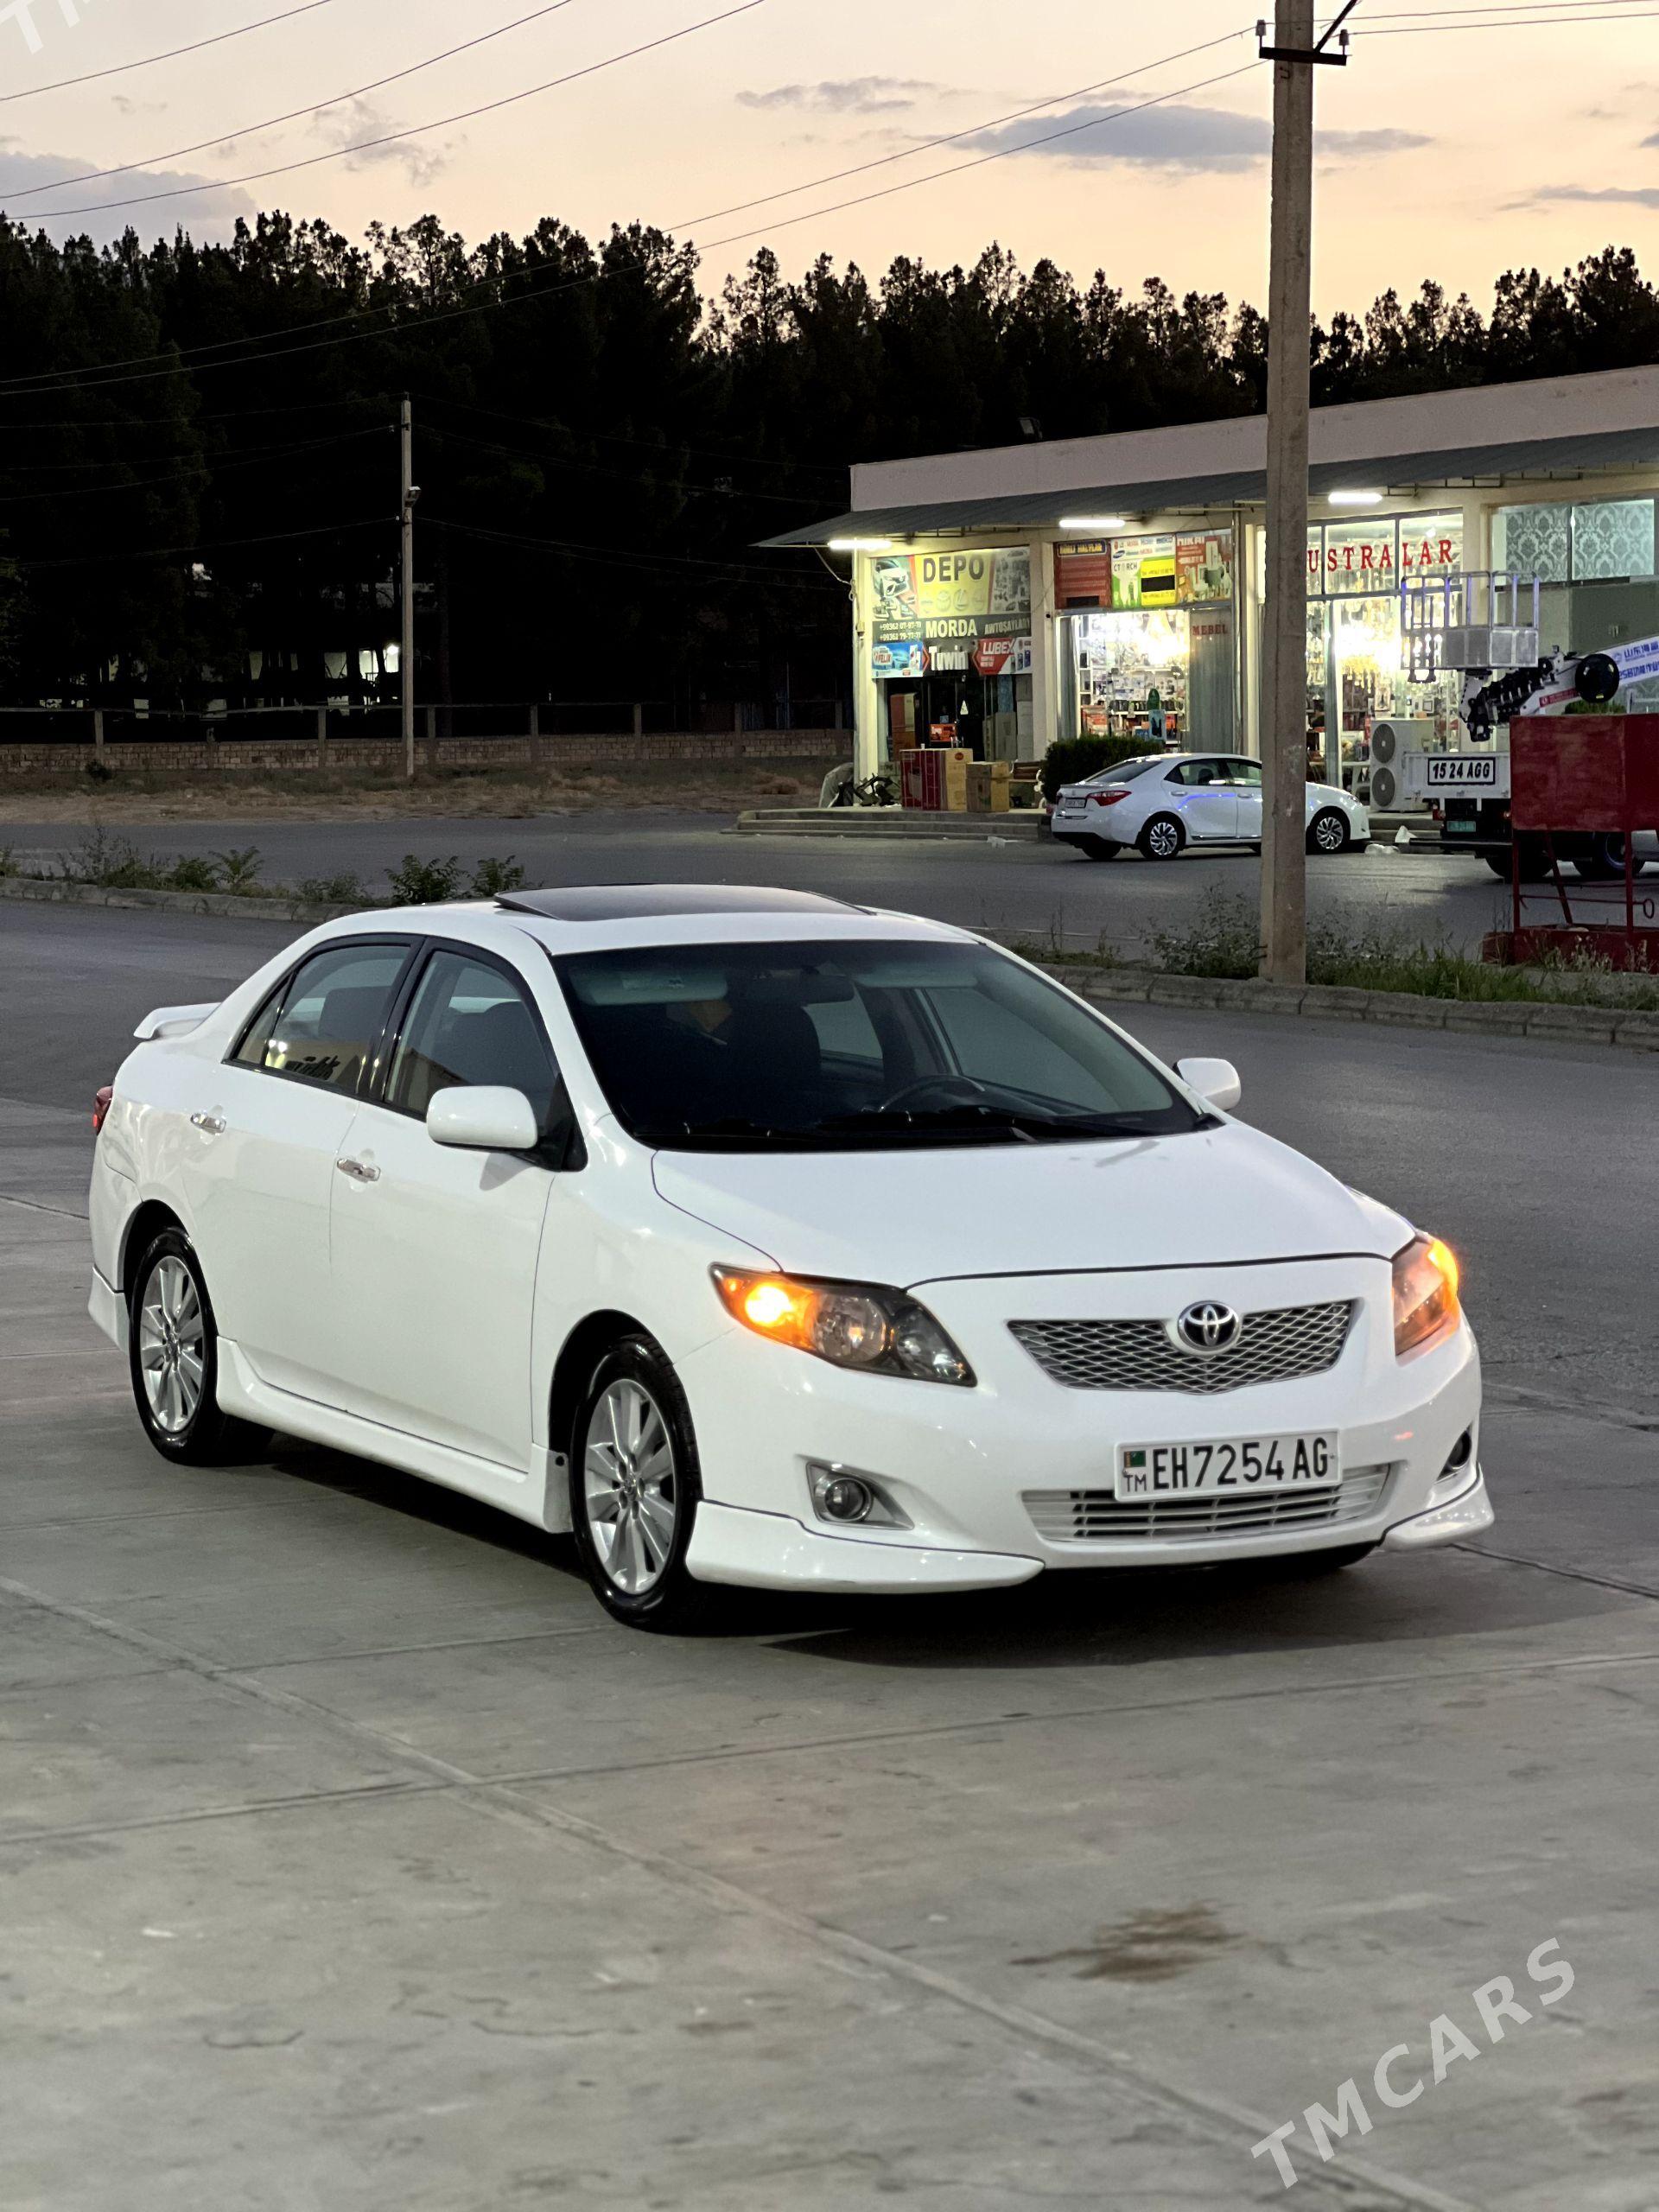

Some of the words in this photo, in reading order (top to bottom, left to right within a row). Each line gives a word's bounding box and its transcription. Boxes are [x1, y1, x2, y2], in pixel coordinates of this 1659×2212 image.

[1307, 539, 1452, 573] USTRALAR
[923, 556, 984, 583] DEPO
[925, 619, 977, 638] MORDA
[982, 638, 1014, 655] LUBEX
[1467, 762, 1491, 779] AGG
[1124, 1473, 1147, 1493] TM
